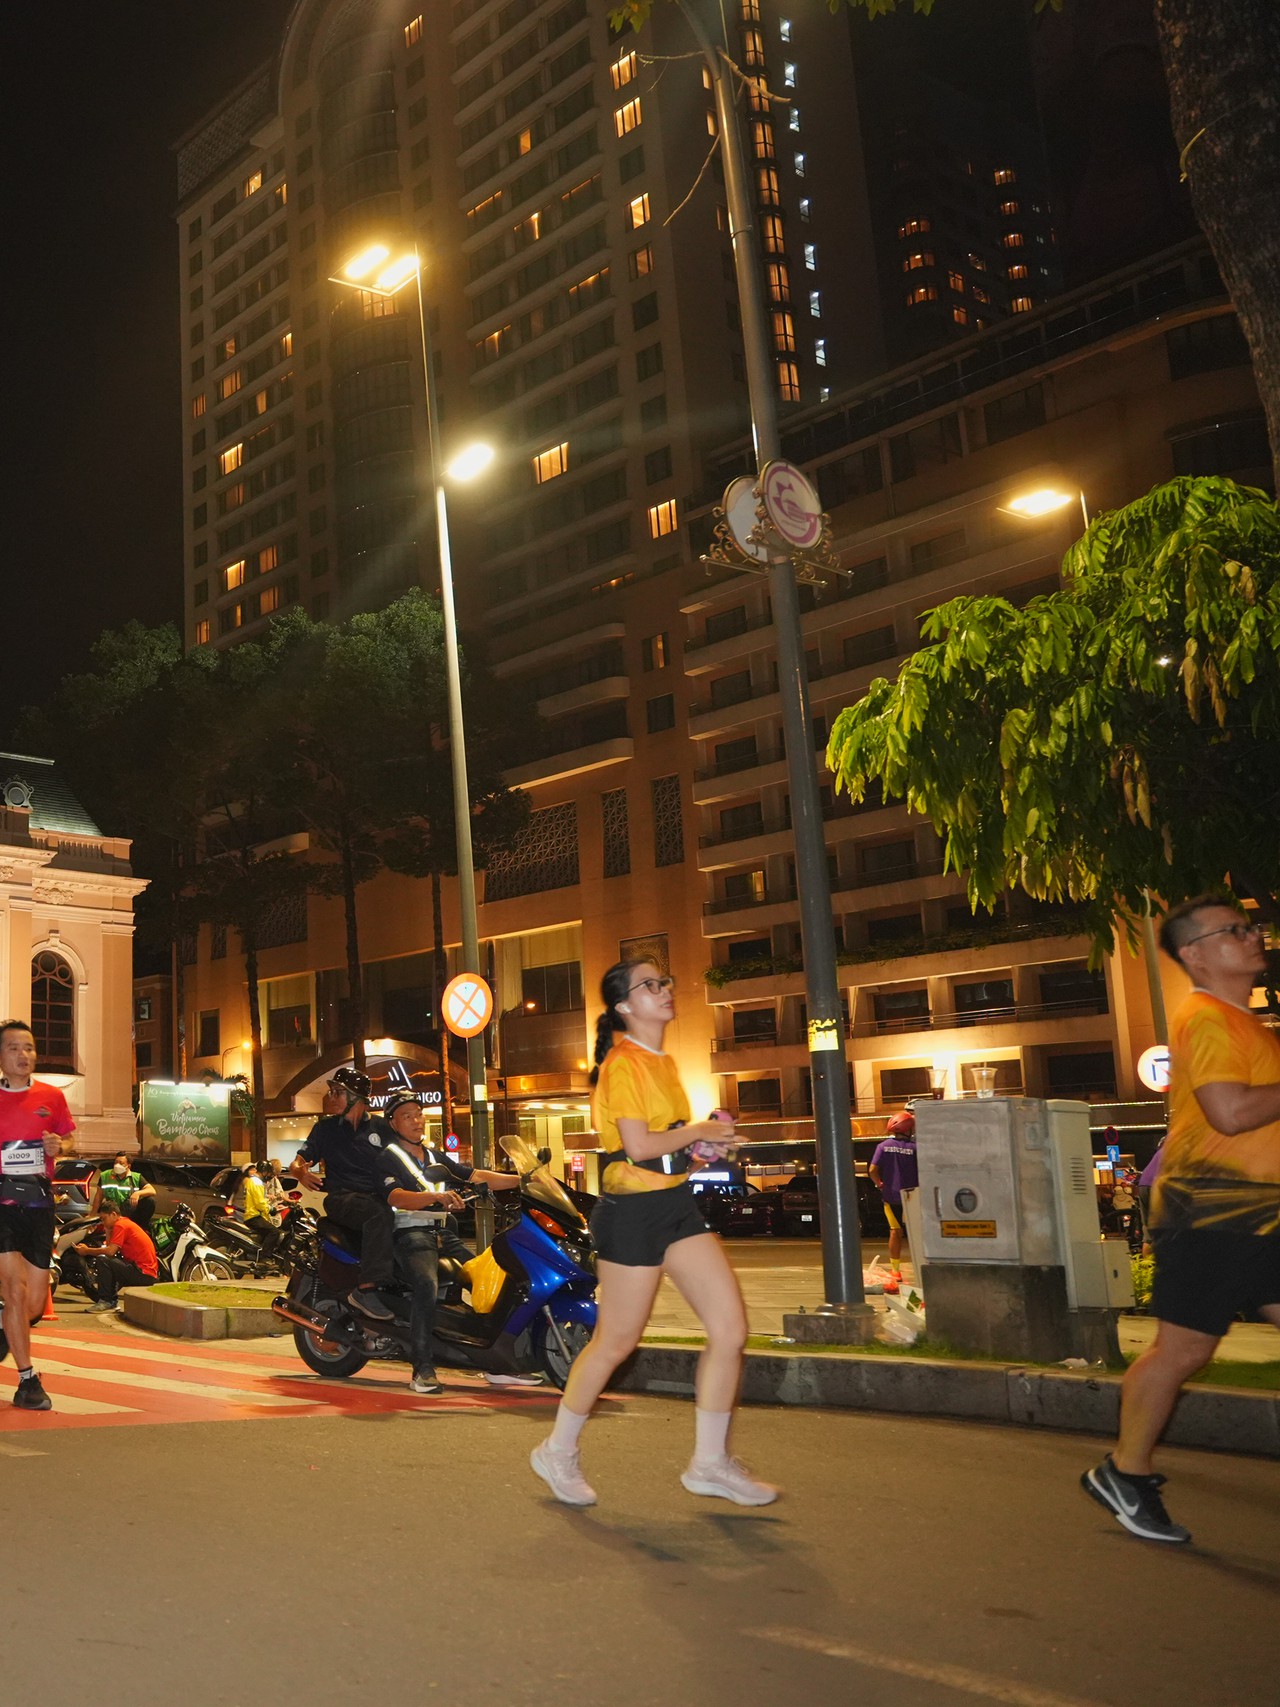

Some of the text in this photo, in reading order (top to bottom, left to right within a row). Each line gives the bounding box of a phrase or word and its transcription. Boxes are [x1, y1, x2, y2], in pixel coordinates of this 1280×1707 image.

[417, 1091, 442, 1104] AIGO
[156, 1118, 220, 1136] Bamboo Circus
[8, 1152, 31, 1160] 61009
